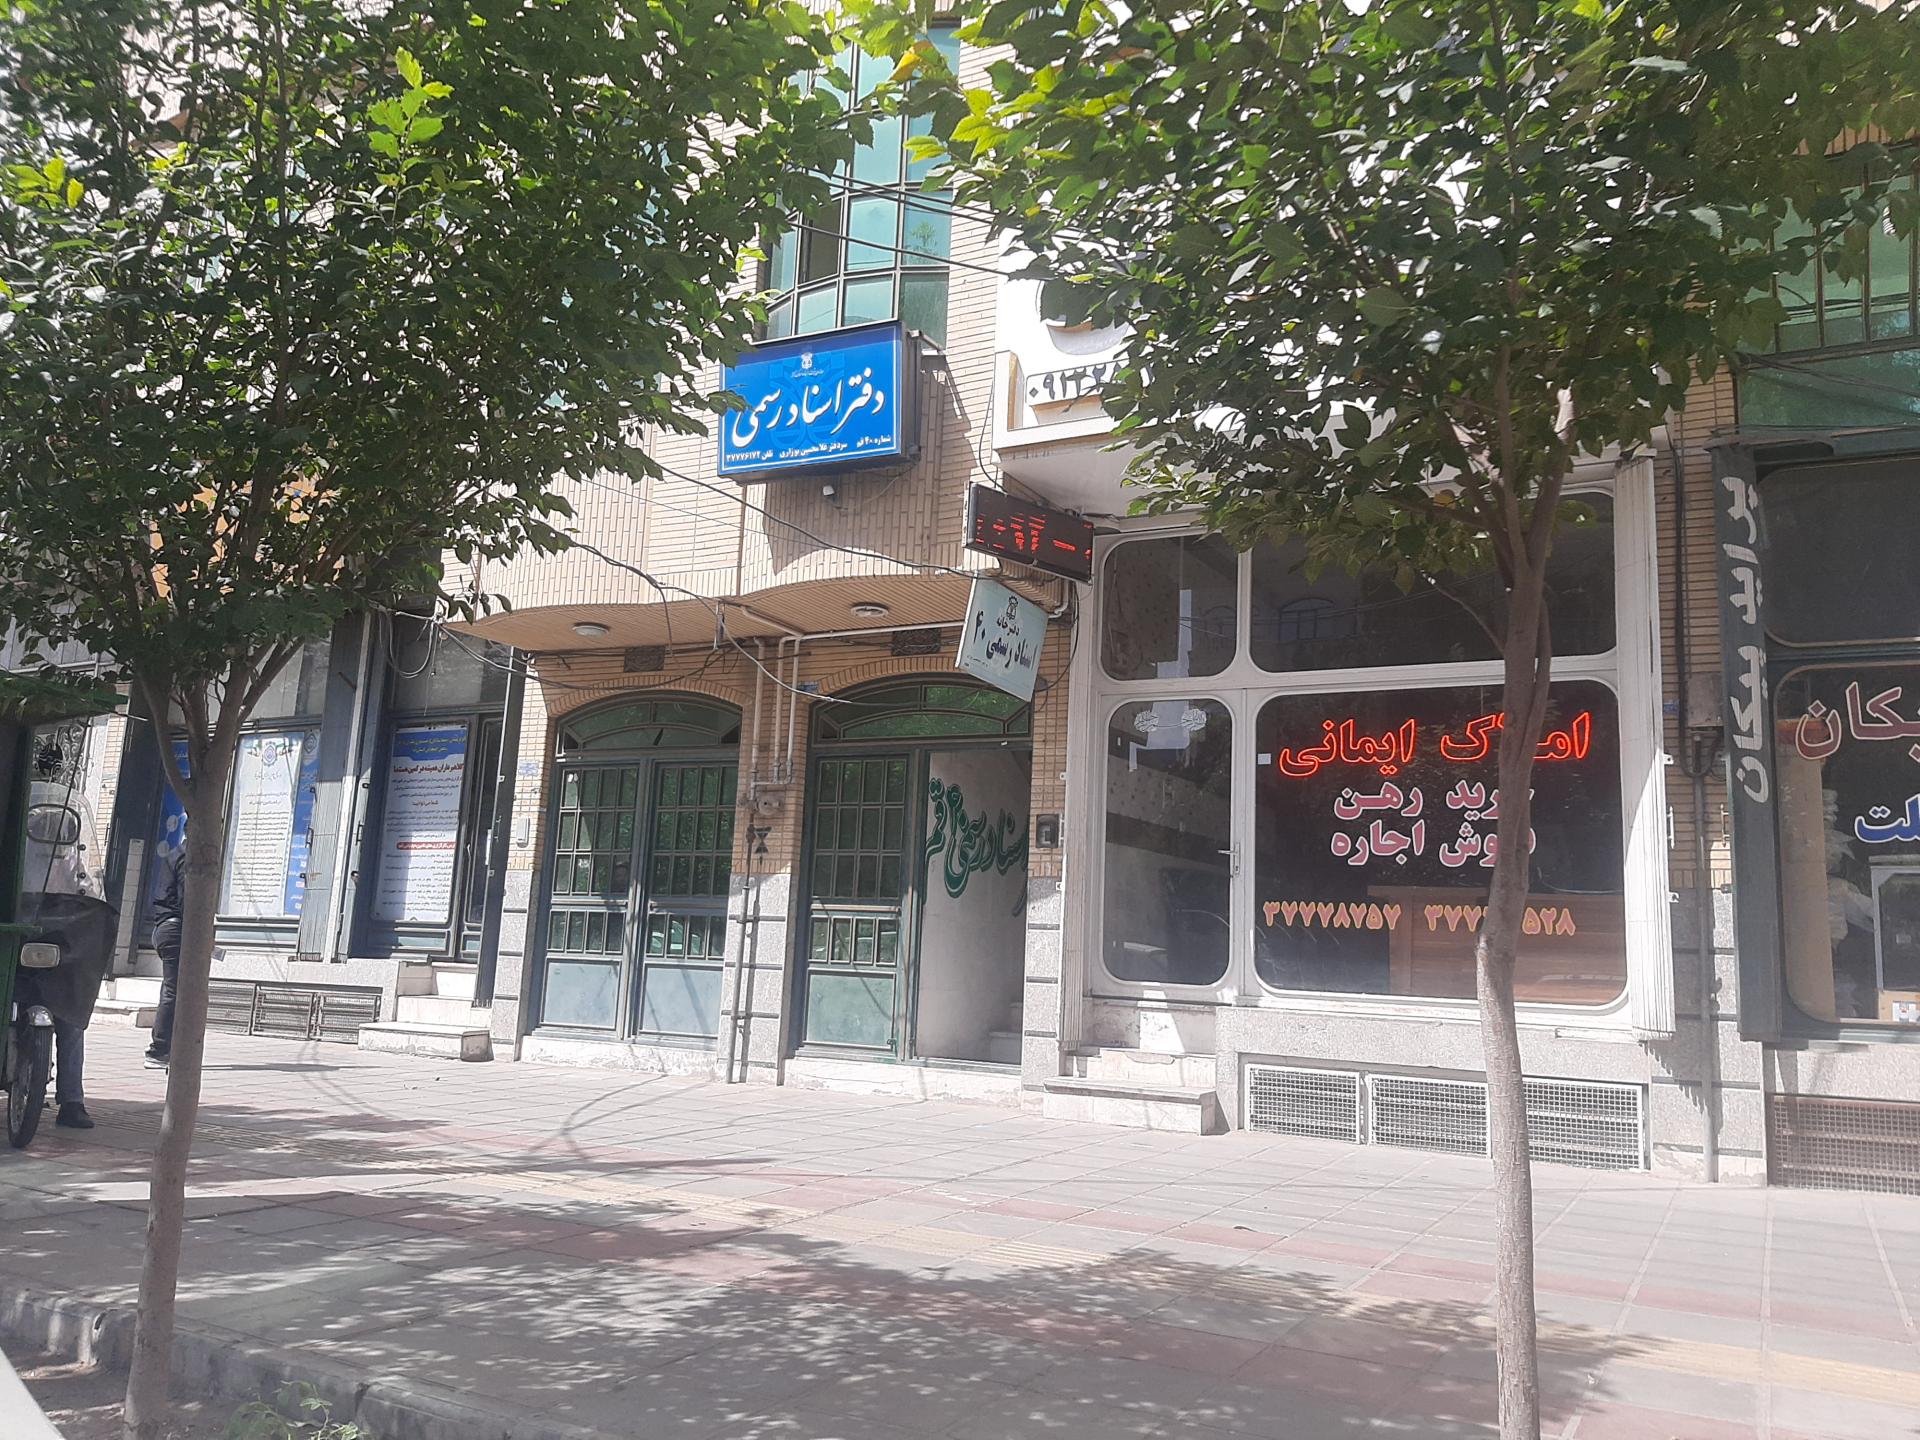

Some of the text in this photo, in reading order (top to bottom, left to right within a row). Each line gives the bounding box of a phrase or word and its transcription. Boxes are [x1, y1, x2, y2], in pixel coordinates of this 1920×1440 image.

[731, 367, 885, 448] دفتر اسناد رسمی
[986, 637, 1013, 669] رسمی
[1014, 639, 1038, 670] اسناد
[1279, 710, 1591, 777] امک ایمانی
[1730, 645, 1769, 803] پیکان
[1335, 780, 1535, 821] رید رهن
[1331, 819, 1536, 868] وش اجاره
[1262, 900, 1576, 937] ۳۷۷۷۸۷۵۷ ۳۷۷۵۲۸
